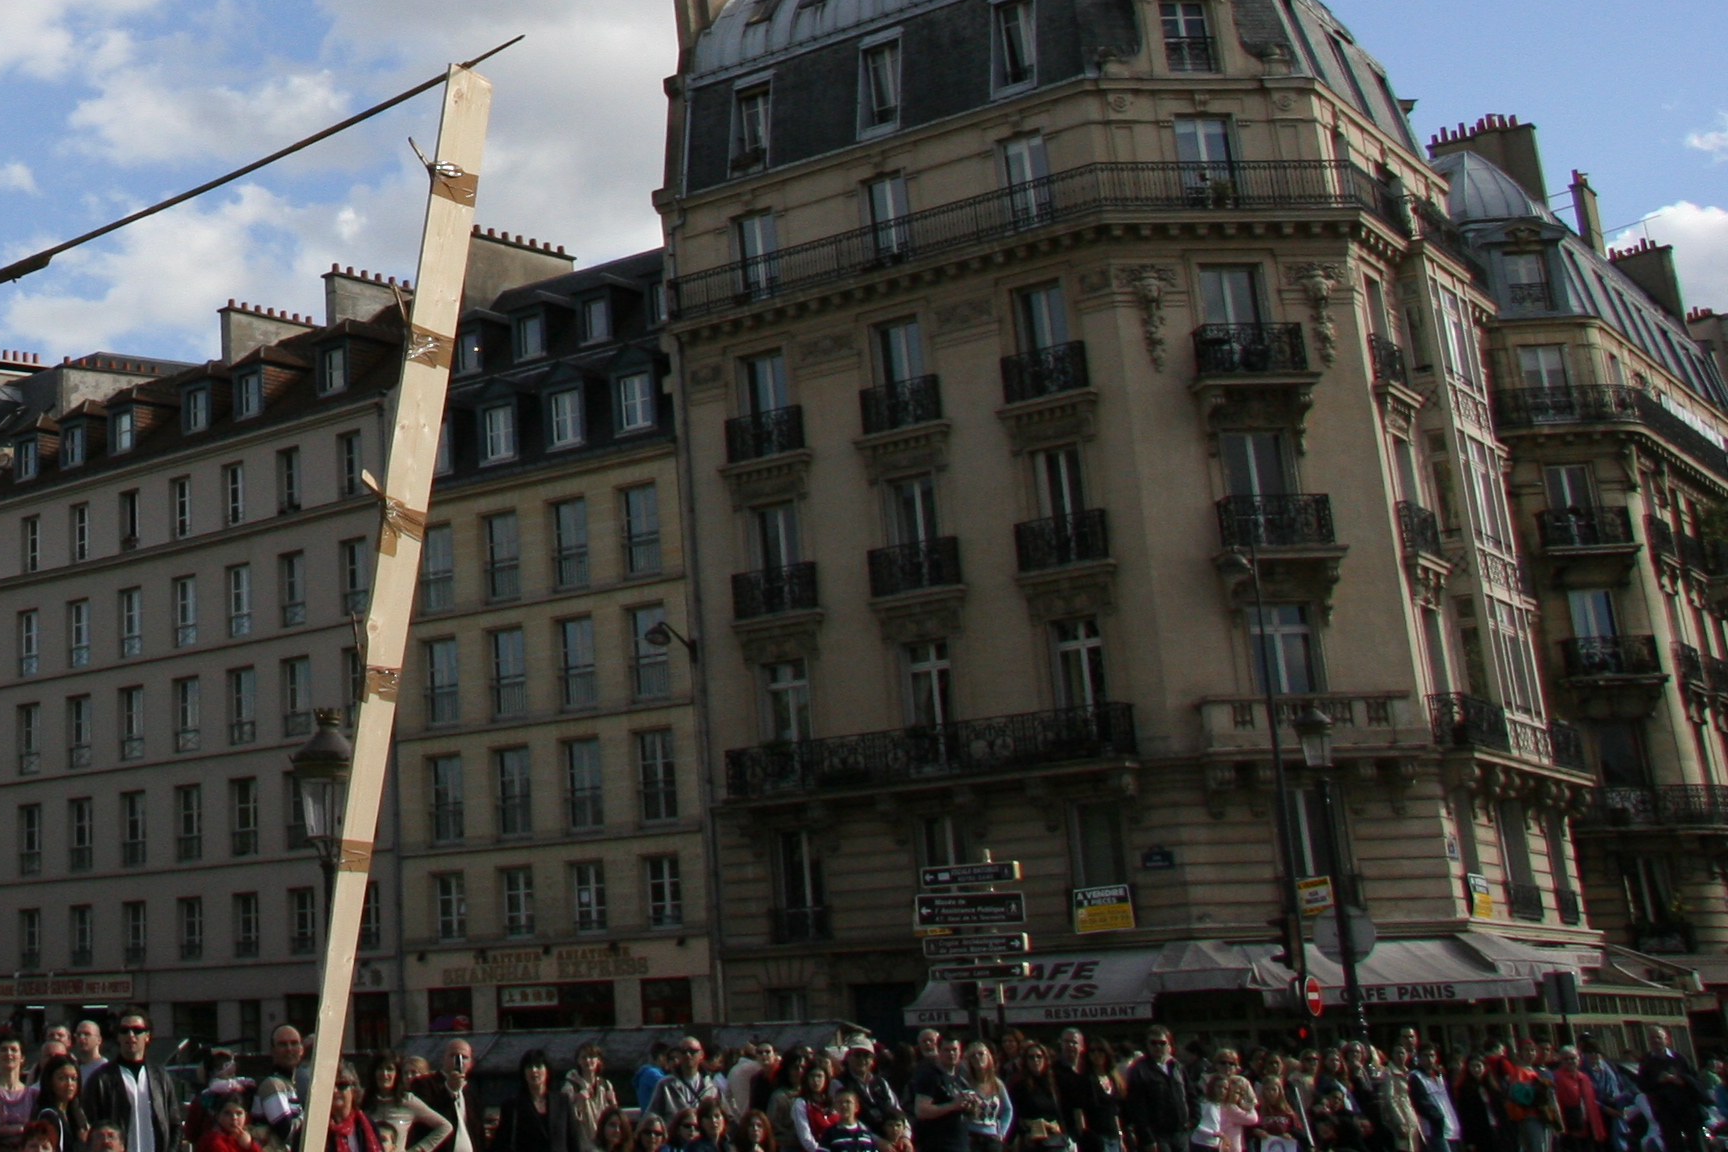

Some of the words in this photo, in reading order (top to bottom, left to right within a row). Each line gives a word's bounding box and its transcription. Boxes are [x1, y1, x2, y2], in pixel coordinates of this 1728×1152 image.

[1076, 892, 1084, 900] A
[1085, 887, 1125, 899] VENDRE
[443, 963, 541, 987] SHANGHAI
[556, 956, 649, 979] EXPRESS
[1020, 960, 1101, 981] AFE
[1397, 984, 1456, 1000] PANIS
[918, 1011, 952, 1023] CAFE
[1044, 1006, 1138, 1019] RESTAURANT
